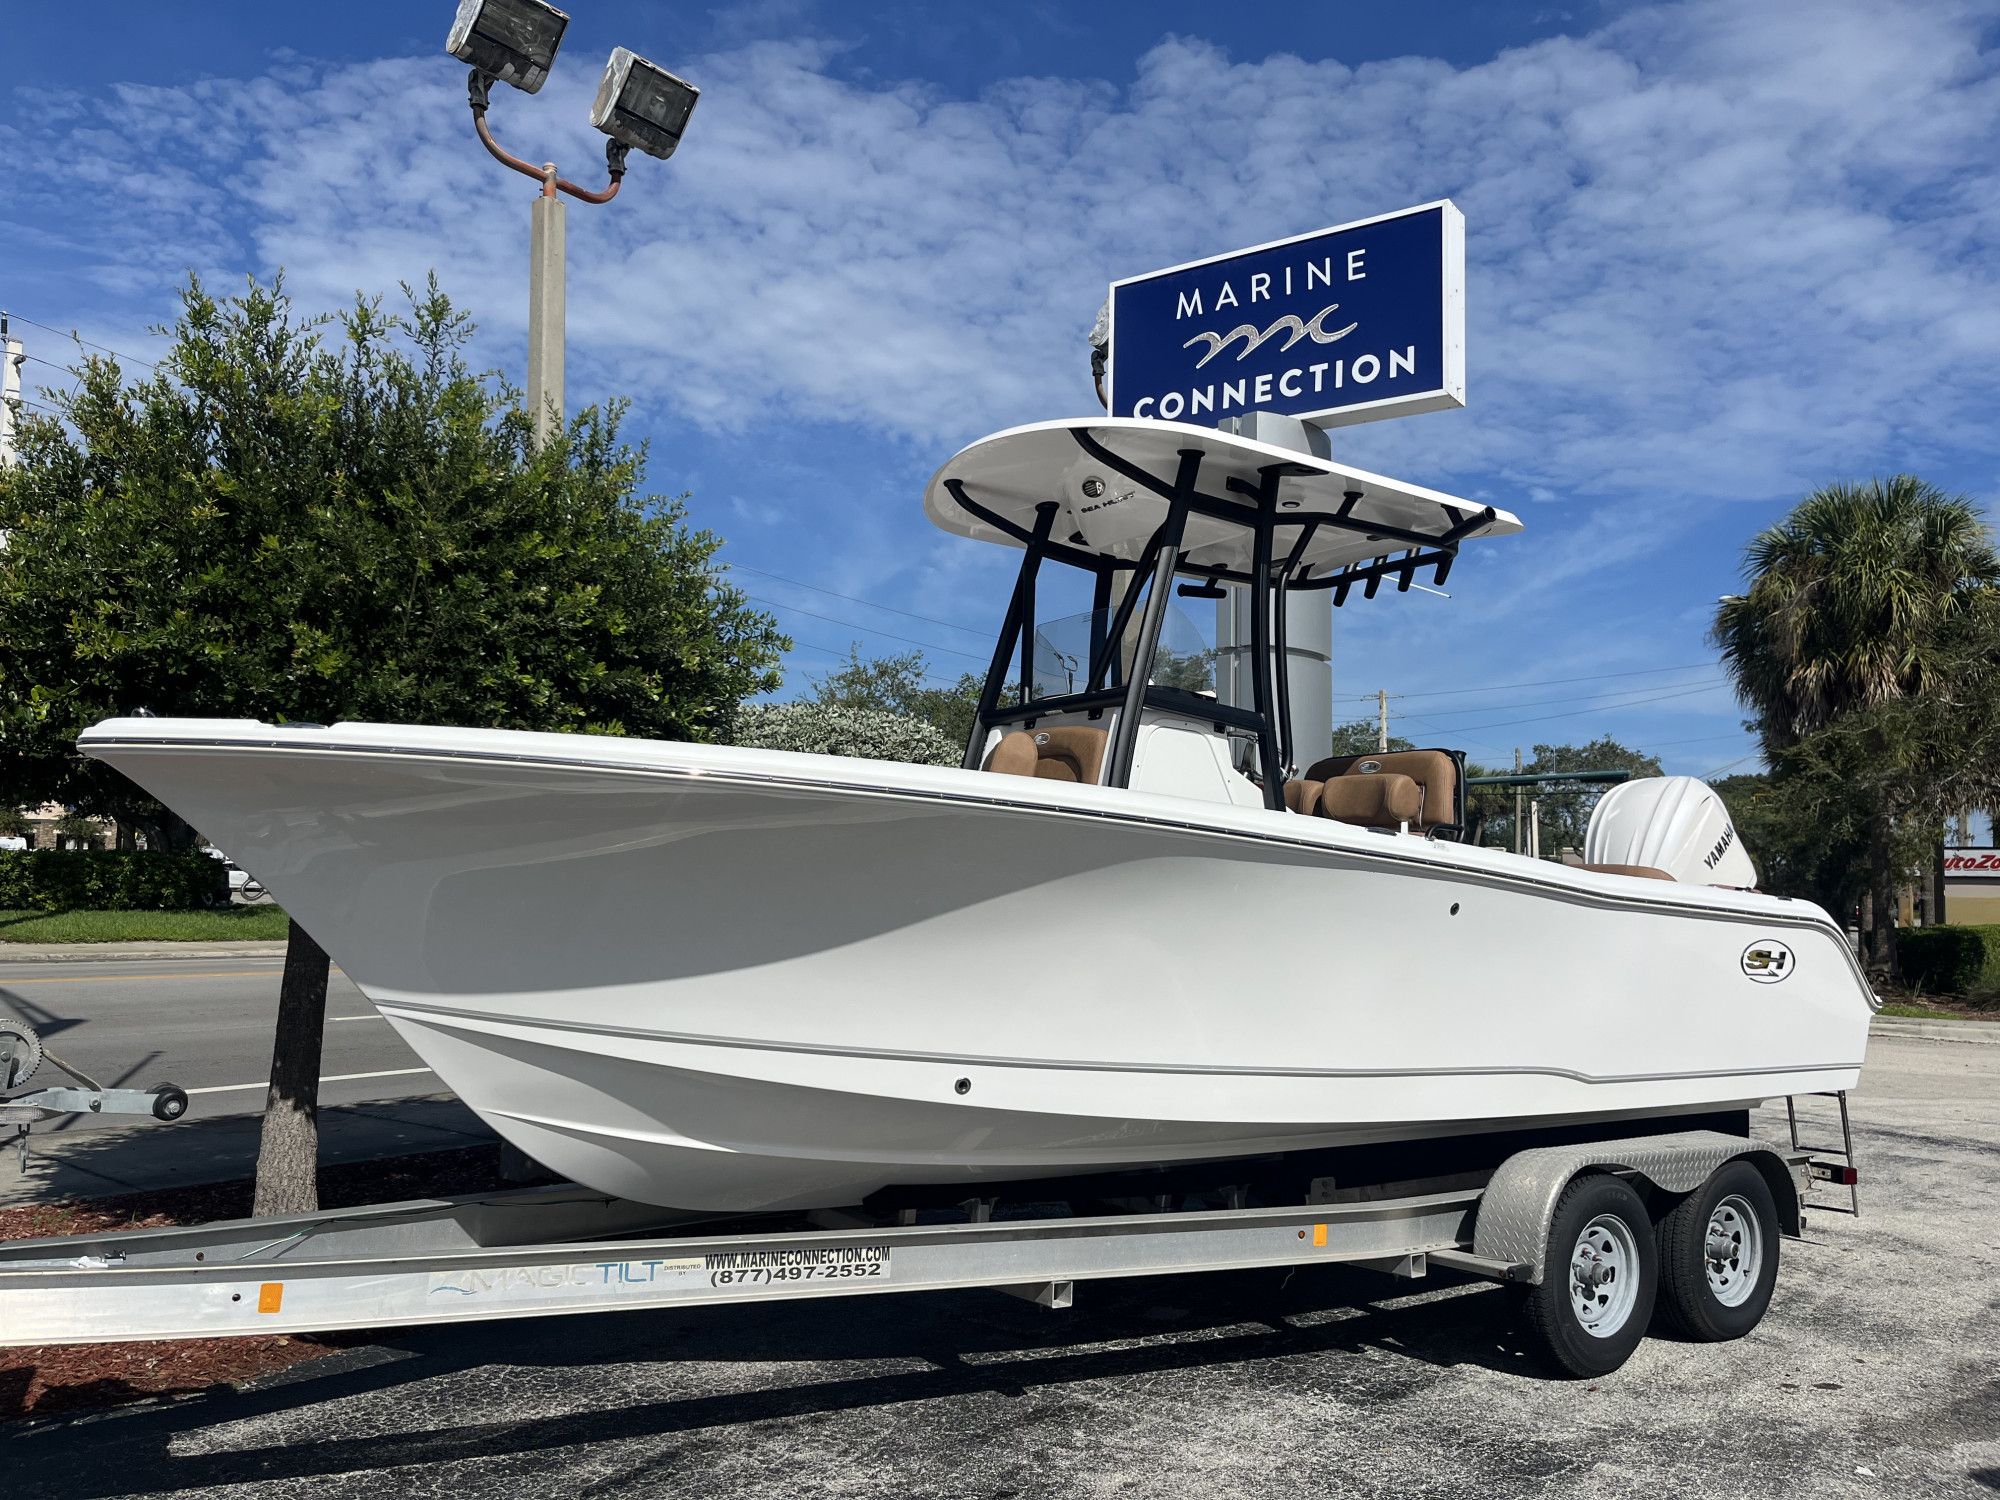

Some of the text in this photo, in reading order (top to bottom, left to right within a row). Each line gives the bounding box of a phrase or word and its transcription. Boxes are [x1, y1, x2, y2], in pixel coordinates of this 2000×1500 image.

[1176, 248, 1366, 320] MARINE
[1133, 345, 1416, 420] CONNECTION
[1703, 822, 1734, 870] YAMAHA
[705, 1246, 891, 1270] WWW.MARINECONNECTION.COM
[710, 1263, 881, 1288] (877)497-2552
